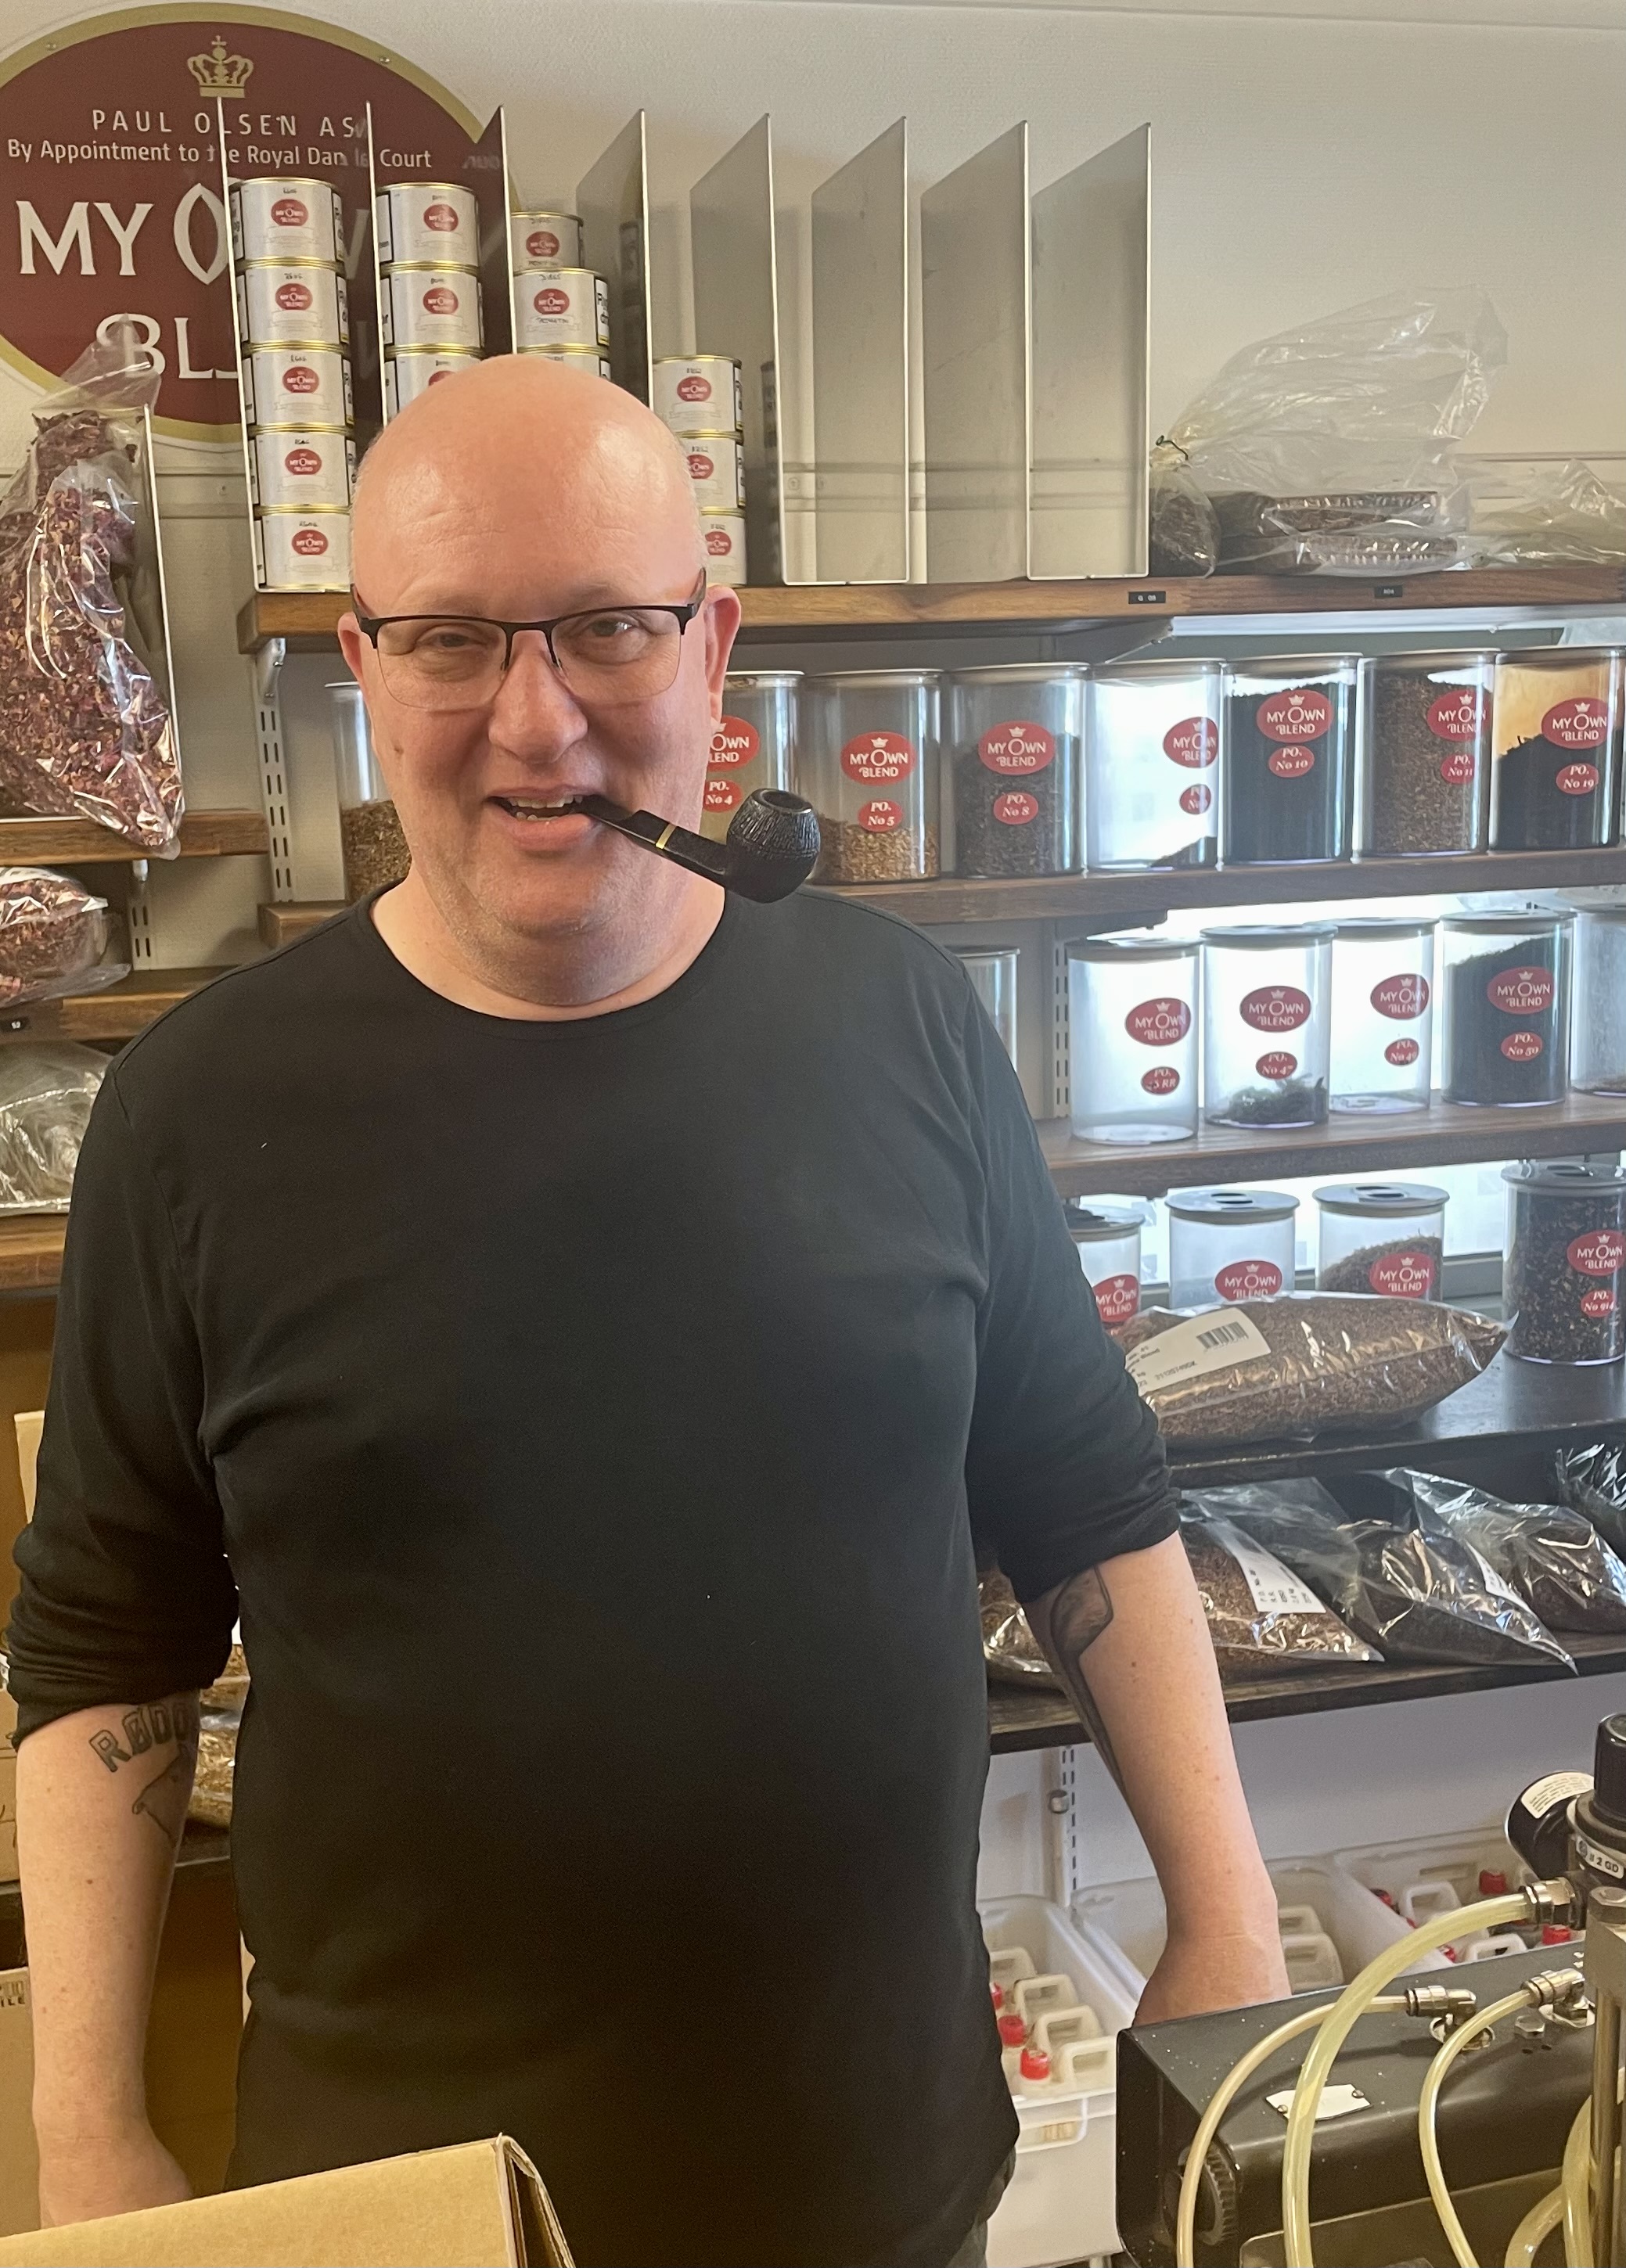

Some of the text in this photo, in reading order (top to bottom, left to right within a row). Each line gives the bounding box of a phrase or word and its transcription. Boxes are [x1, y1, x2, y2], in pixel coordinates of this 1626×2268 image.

[92, 109, 172, 133] PAUL
[8, 138, 32, 163] By
[40, 139, 171, 164] Appointment
[178, 143, 200, 162] to
[207, 144, 239, 164] te
[247, 145, 300, 169] Royal
[380, 149, 432, 168] Court
[15, 200, 155, 276] MY
[1267, 706, 1326, 724] MY OWN
[1438, 710, 1456, 722] MY
[1552, 713, 1607, 730] MY OWN
[1275, 724, 1315, 735] BLEND
[1447, 723, 1477, 734] BLEN
[1562, 730, 1599, 741] BLEND
[710, 733, 750, 752] OWN
[987, 738, 1046, 756] MY OWN
[1174, 736, 1191, 749] MY
[709, 751, 739, 763] LEND
[850, 749, 908, 767] MY OWN
[1282, 747, 1303, 758] PO.
[996, 756, 1036, 767] BLEND
[1275, 760, 1308, 771] No 10
[858, 767, 899, 778] BLEND
[1570, 764, 1590, 775] PO.
[709, 781, 730, 792] PO.
[1563, 778, 1595, 789] No 19
[705, 793, 733, 805] No 4
[1006, 794, 1027, 804] PO.
[871, 801, 892, 812] PO.
[1002, 806, 1030, 818] No 8
[867, 815, 895, 826] No 5
[1497, 981, 1550, 997] MY OWN
[1380, 991, 1398, 1002] MY
[1506, 997, 1542, 1008] BLEND
[1249, 1000, 1304, 1016] MY OWN
[1388, 1004, 1418, 1014] BLEN
[1135, 1012, 1186, 1030] MY OWN
[1257, 1015, 1295, 1026] BLEND
[1144, 1028, 1179, 1040] BLEND
[1514, 1033, 1534, 1043] PO.
[1507, 1046, 1523, 1056] No
[1577, 1244, 1623, 1260] MY OWN
[1585, 1259, 1617, 1269] BLEND
[1225, 1273, 1276, 1289] MY OWN
[1380, 1267, 1430, 1283] MY OWN
[1388, 1281, 1422, 1292] BLEND
[1095, 1289, 1136, 1306] MY OWN
[1596, 1856, 1603, 1867] 2
[1604, 1860, 1619, 1874] GD
